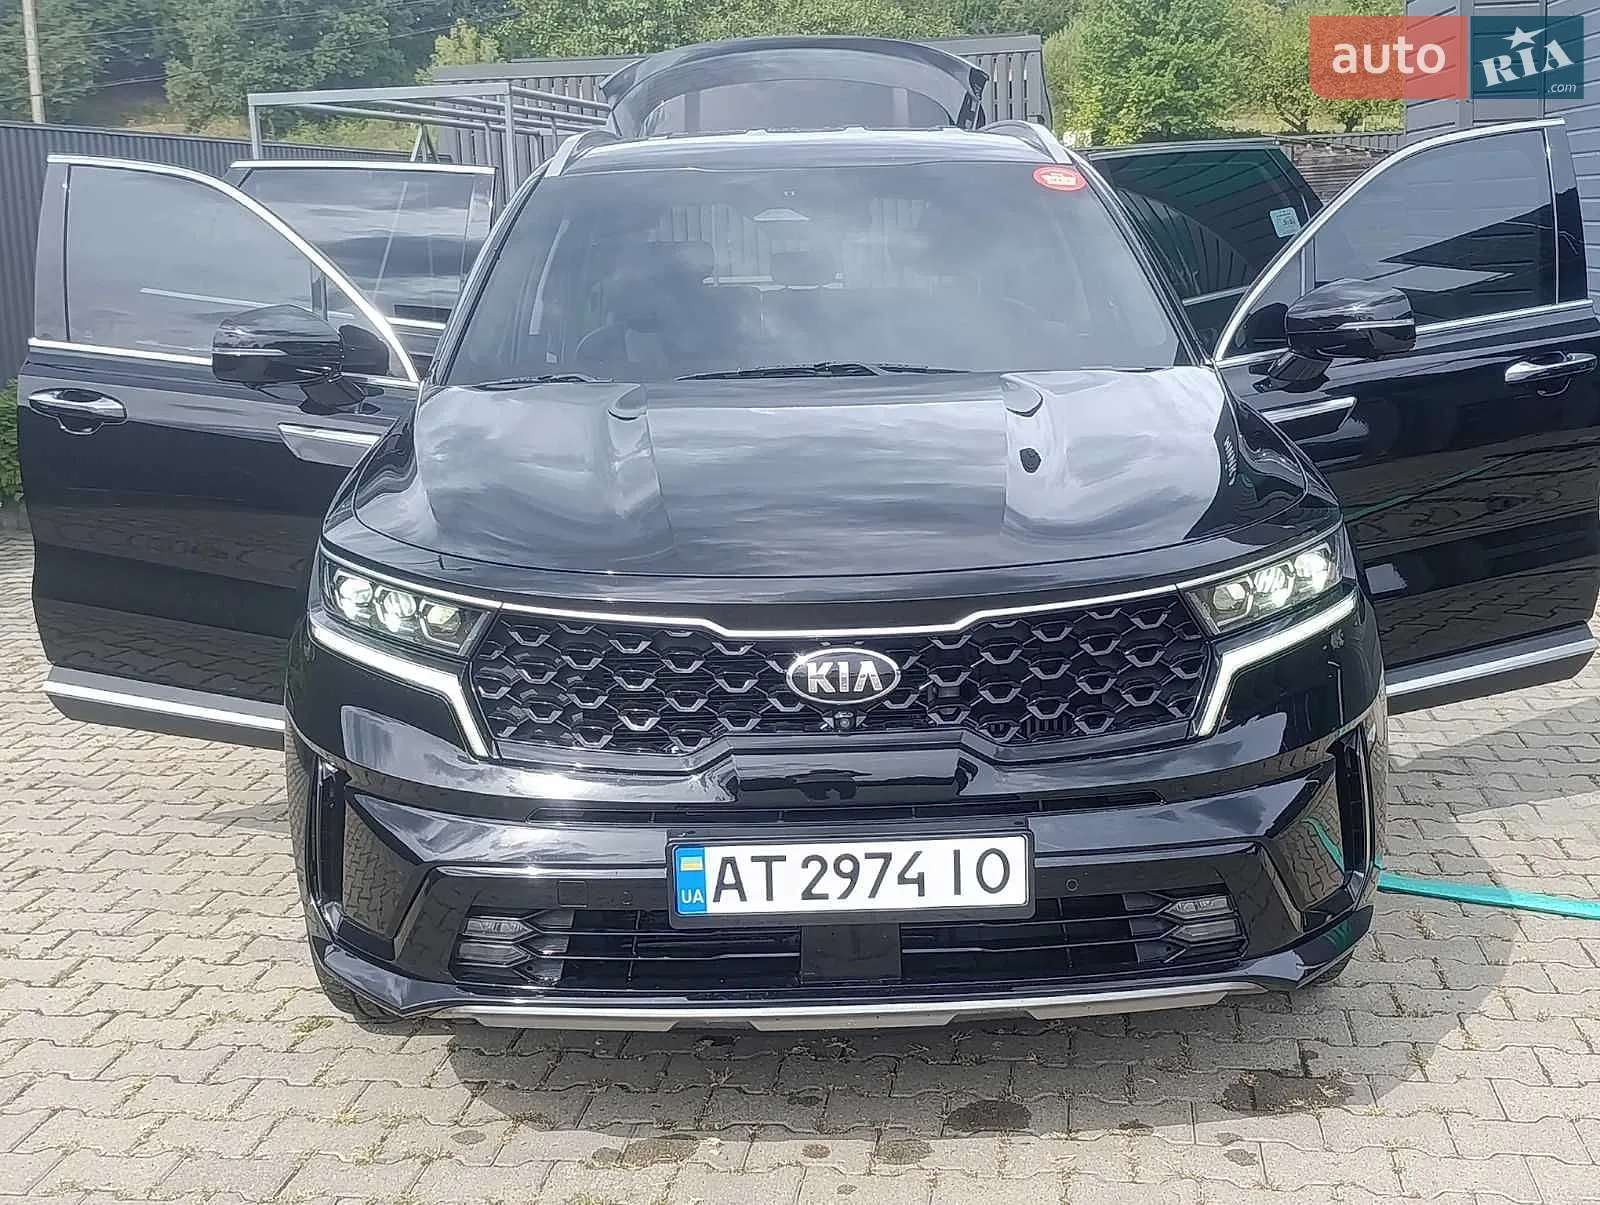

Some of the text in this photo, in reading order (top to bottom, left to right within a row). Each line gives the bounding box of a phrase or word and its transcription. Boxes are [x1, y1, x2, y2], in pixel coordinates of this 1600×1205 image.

[807, 661, 883, 693] KIA
[712, 847, 1010, 902] AT 2974 IO
[681, 890, 704, 904] UA
